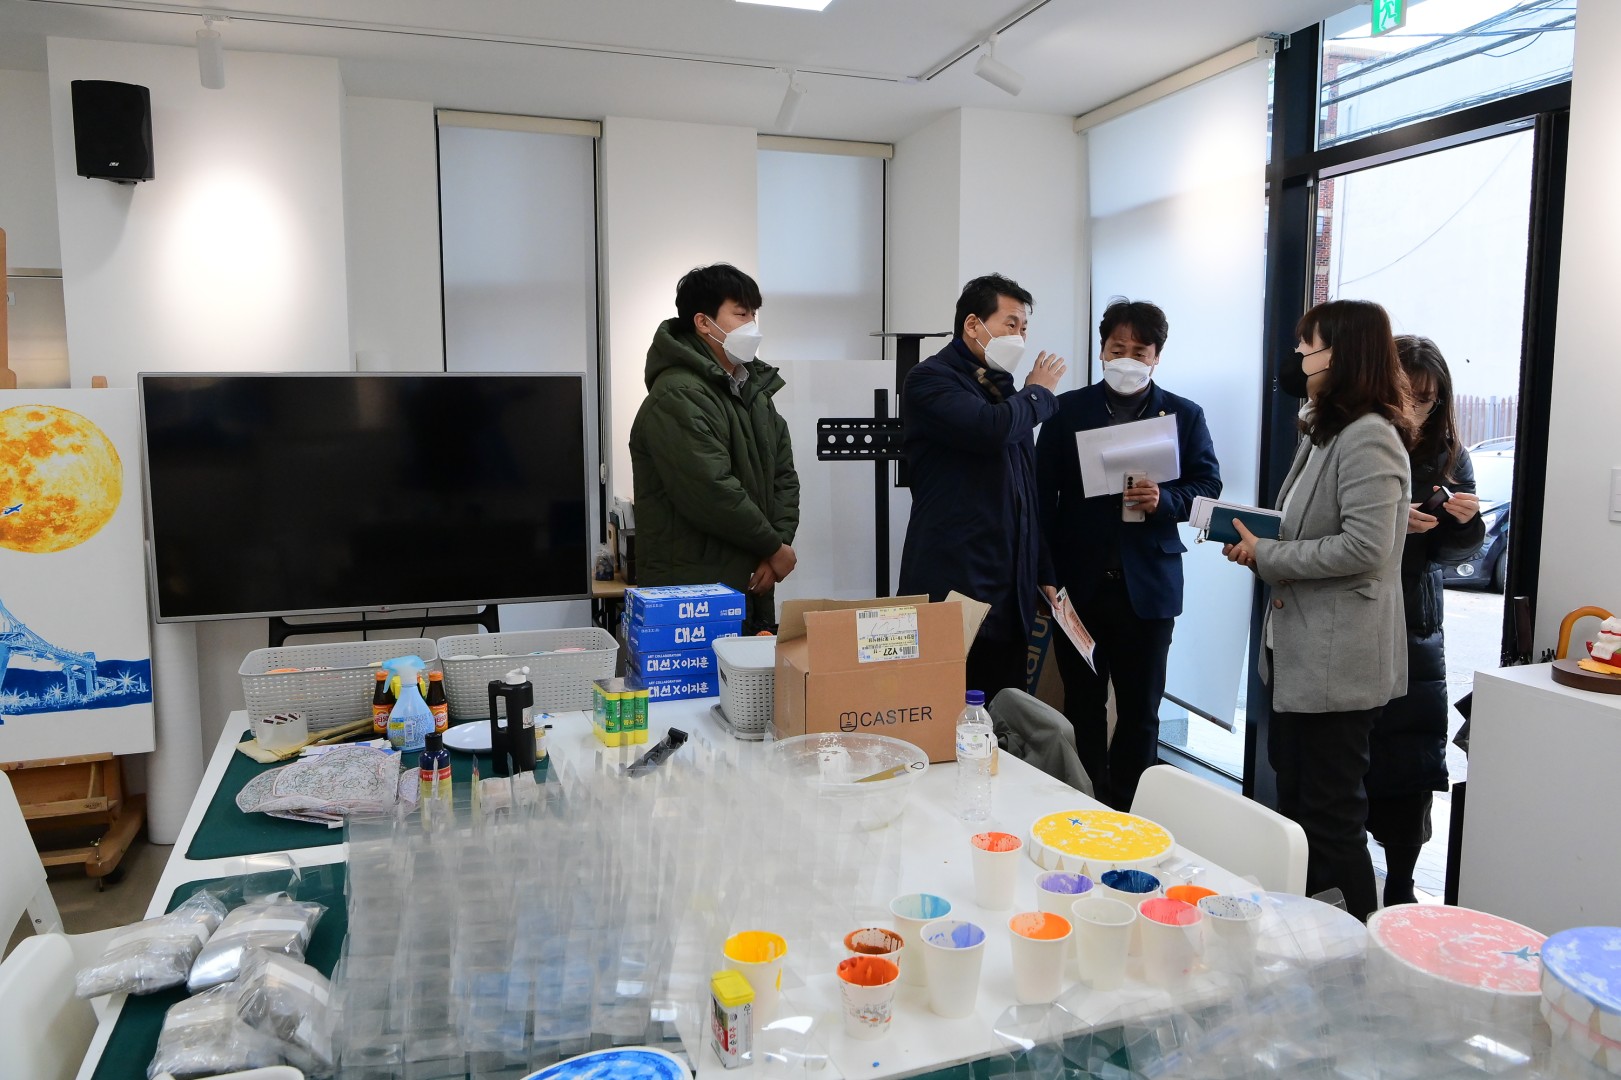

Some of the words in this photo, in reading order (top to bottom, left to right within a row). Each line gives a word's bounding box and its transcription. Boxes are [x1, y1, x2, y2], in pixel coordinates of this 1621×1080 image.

[679, 601, 709, 618] 대선
[675, 626, 706, 643] 대선
[883, 648, 898, 656] Y27
[647, 659, 670, 671] 대선
[681, 656, 709, 669] 이지훈
[648, 685, 671, 697] 대선
[682, 681, 709, 694] 이지훈
[860, 706, 932, 727] CASTER
